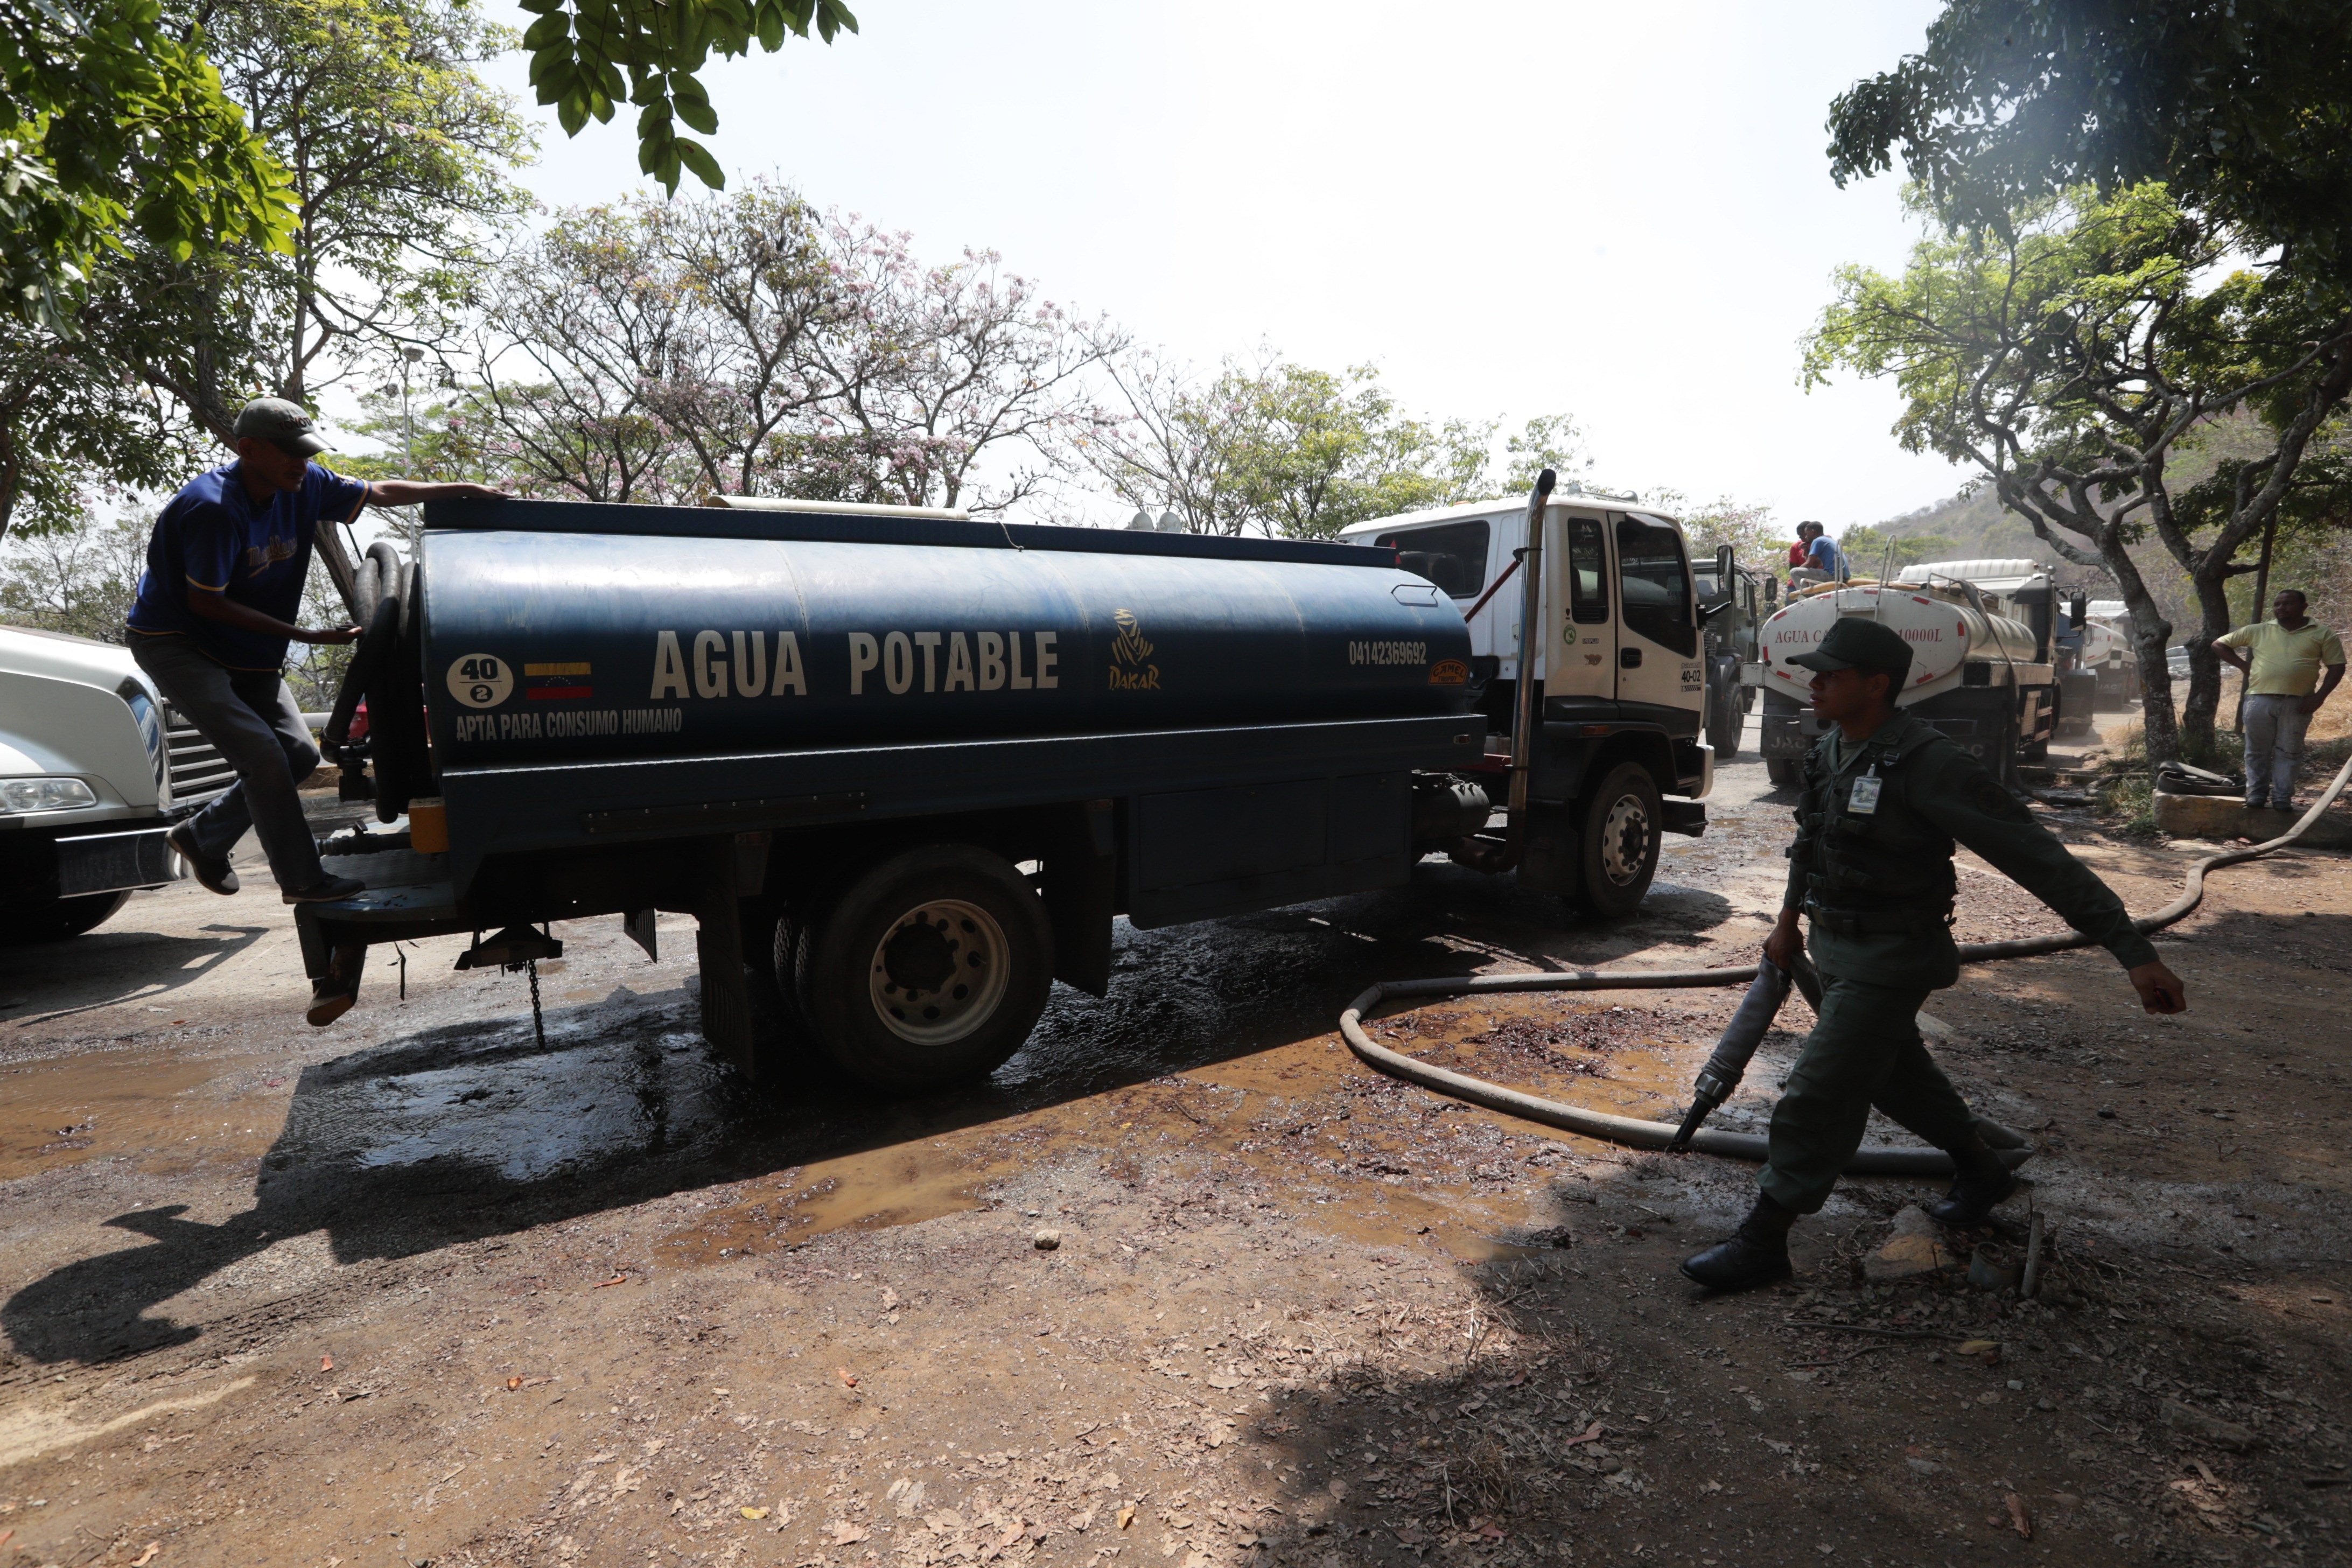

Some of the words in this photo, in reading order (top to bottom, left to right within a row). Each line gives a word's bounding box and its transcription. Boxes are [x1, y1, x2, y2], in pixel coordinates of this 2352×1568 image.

[276, 416, 313, 432] TOYOT
[1775, 630, 1809, 643] AGUA
[1898, 628, 1943, 642] 10000L
[1349, 641, 1426, 665] 04142369692
[460, 659, 498, 680] 40
[650, 630, 807, 699] AGUA
[849, 631, 1059, 695] POTABLE
[1433, 663, 1465, 678] CAMEL
[1109, 664, 1161, 690] DAKAR
[1681, 670, 1701, 683] 40-02
[476, 688, 488, 699] 2
[457, 715, 497, 741] APTA
[500, 713, 542, 739] PARA
[547, 710, 618, 738] CONSUMO
[622, 708, 682, 734] HUMANO
[1770, 737, 1805, 748] JAC
